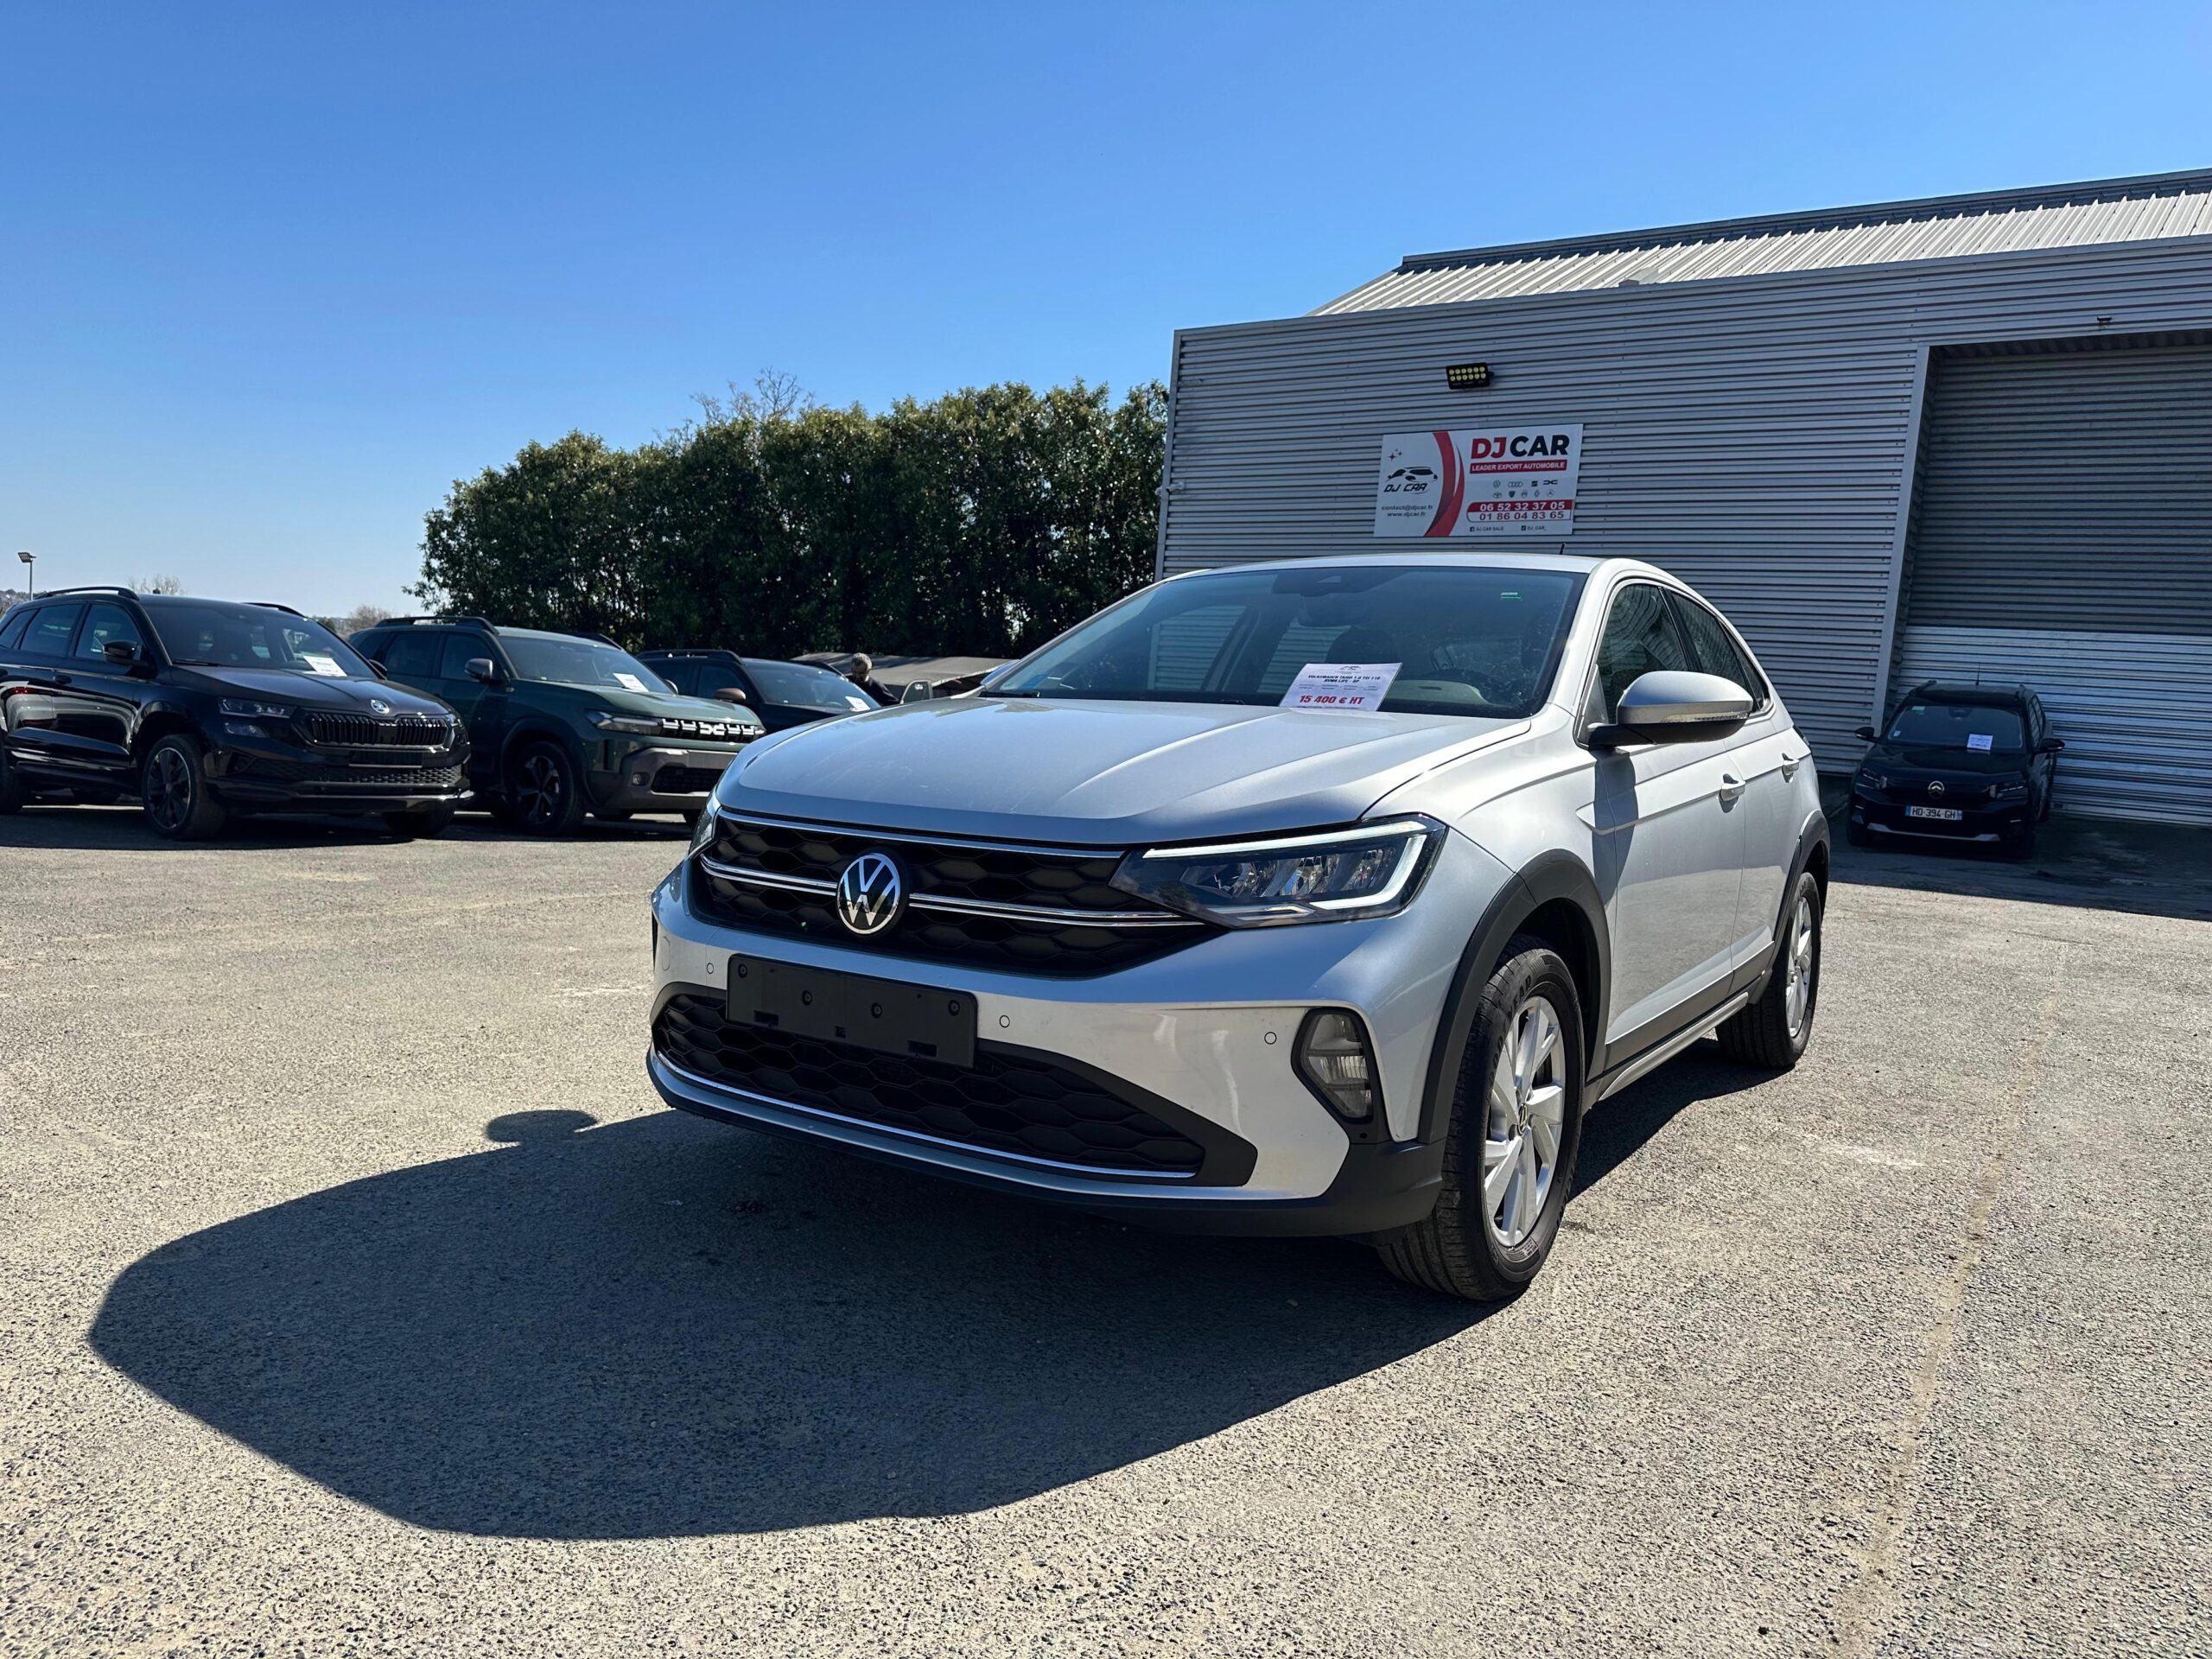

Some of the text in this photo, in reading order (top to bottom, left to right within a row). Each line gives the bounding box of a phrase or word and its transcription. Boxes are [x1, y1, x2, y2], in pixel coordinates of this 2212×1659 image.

[1471, 435, 1568, 459] DJ CAR
[1383, 483, 1427, 493] DJ CAR
